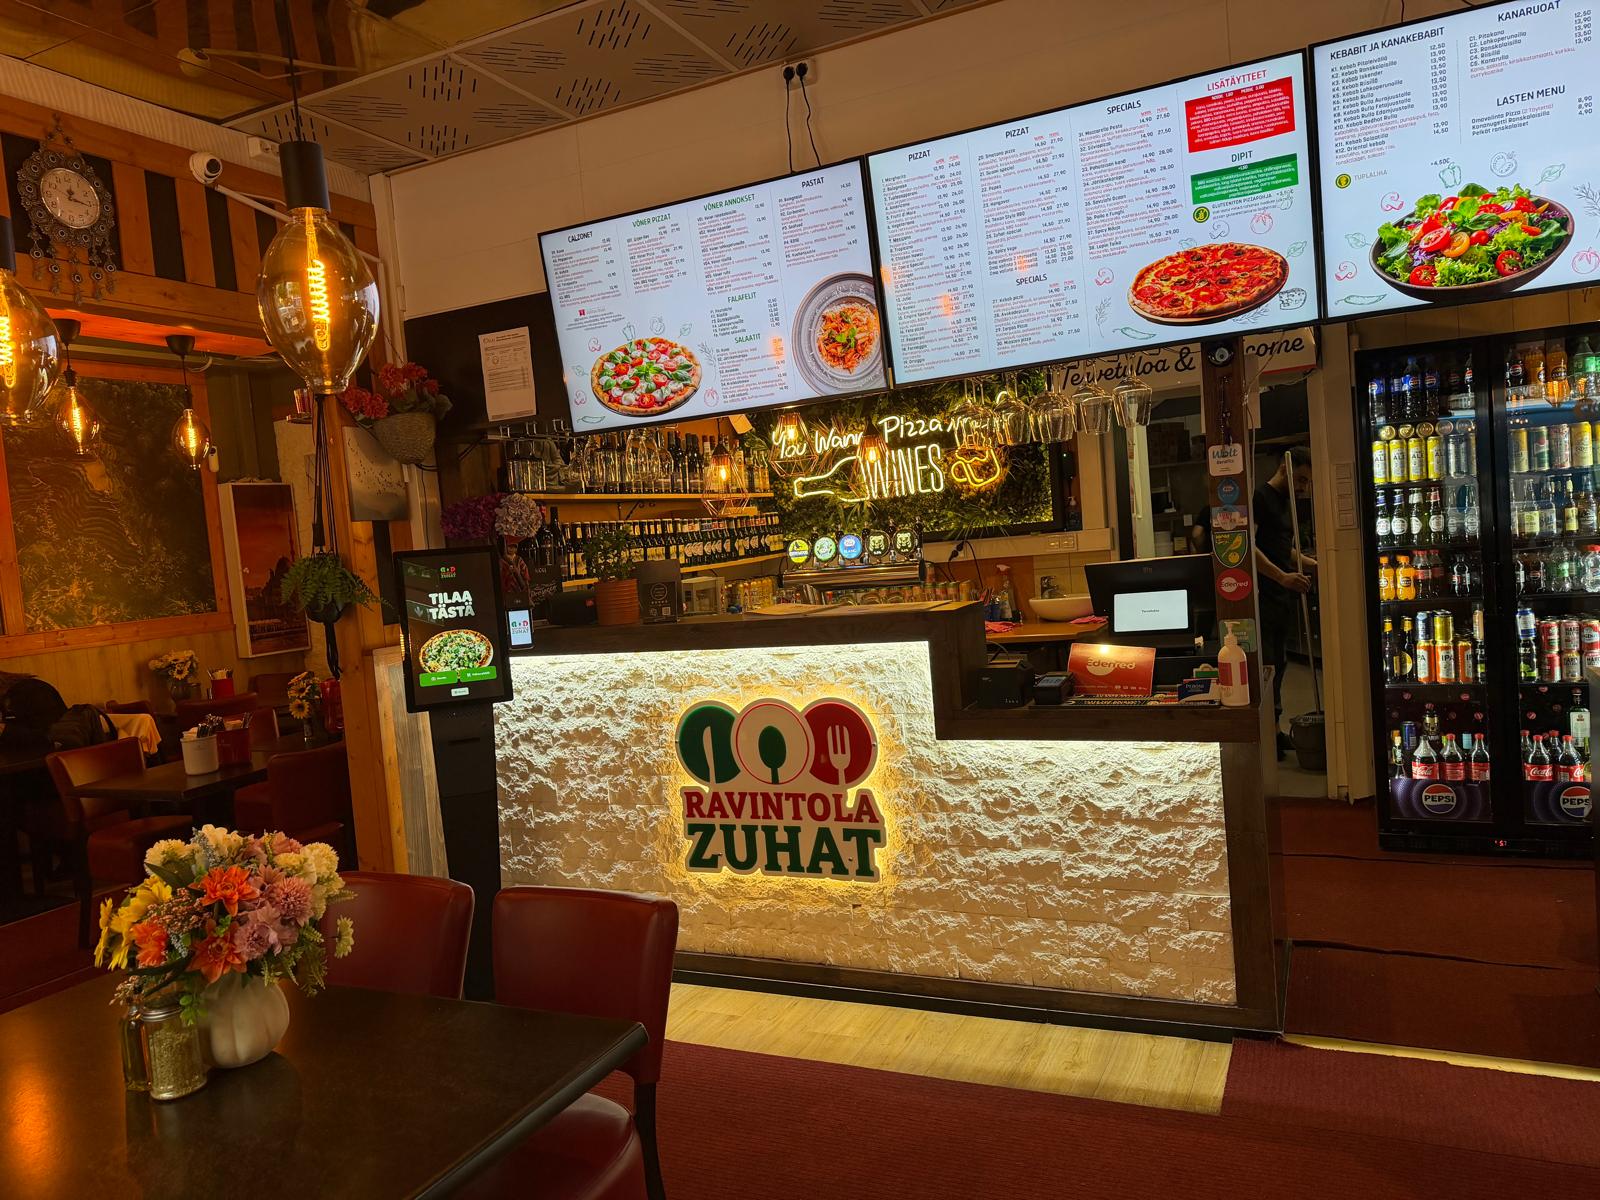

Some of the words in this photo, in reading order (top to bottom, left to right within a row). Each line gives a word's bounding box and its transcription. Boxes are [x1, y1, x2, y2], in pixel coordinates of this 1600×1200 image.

[1498, 0, 1560, 21] KANARUOAT
[1330, 44, 1367, 60] KEBABIT
[1368, 41, 1379, 51] JA
[1381, 26, 1444, 48] KANAKEBABIT
[1207, 69, 1267, 91] LISÄTÄYTTEET
[1497, 91, 1533, 106] LASTEN
[1536, 84, 1565, 98] MENU
[1106, 99, 1141, 114] SPECIALS
[1005, 126, 1029, 138] PIZZAT
[908, 149, 930, 161] PIZZAT
[1231, 150, 1253, 162] DIPIT
[801, 176, 824, 188] PASTAT
[724, 192, 755, 207] ANNOKSET
[651, 212, 671, 223] PIZZAT
[567, 231, 593, 242] CALZONET
[1015, 273, 1047, 285] SPECIALS
[727, 291, 756, 302] FALAFELIT
[734, 333, 760, 343] SALAATIT
[1175, 346, 1196, 372] &
[878, 416, 943, 443] Pizza
[866, 444, 943, 499] WINES
[1221, 579, 1249, 588] Edenred
[428, 590, 473, 605] TILAA
[429, 601, 475, 620] TÄSTÄ
[1087, 658, 1136, 670] Edenred
[1424, 795, 1455, 803] PEPSI
[684, 791, 879, 823] RAVINTOLA
[687, 823, 881, 877] ZUHAT
